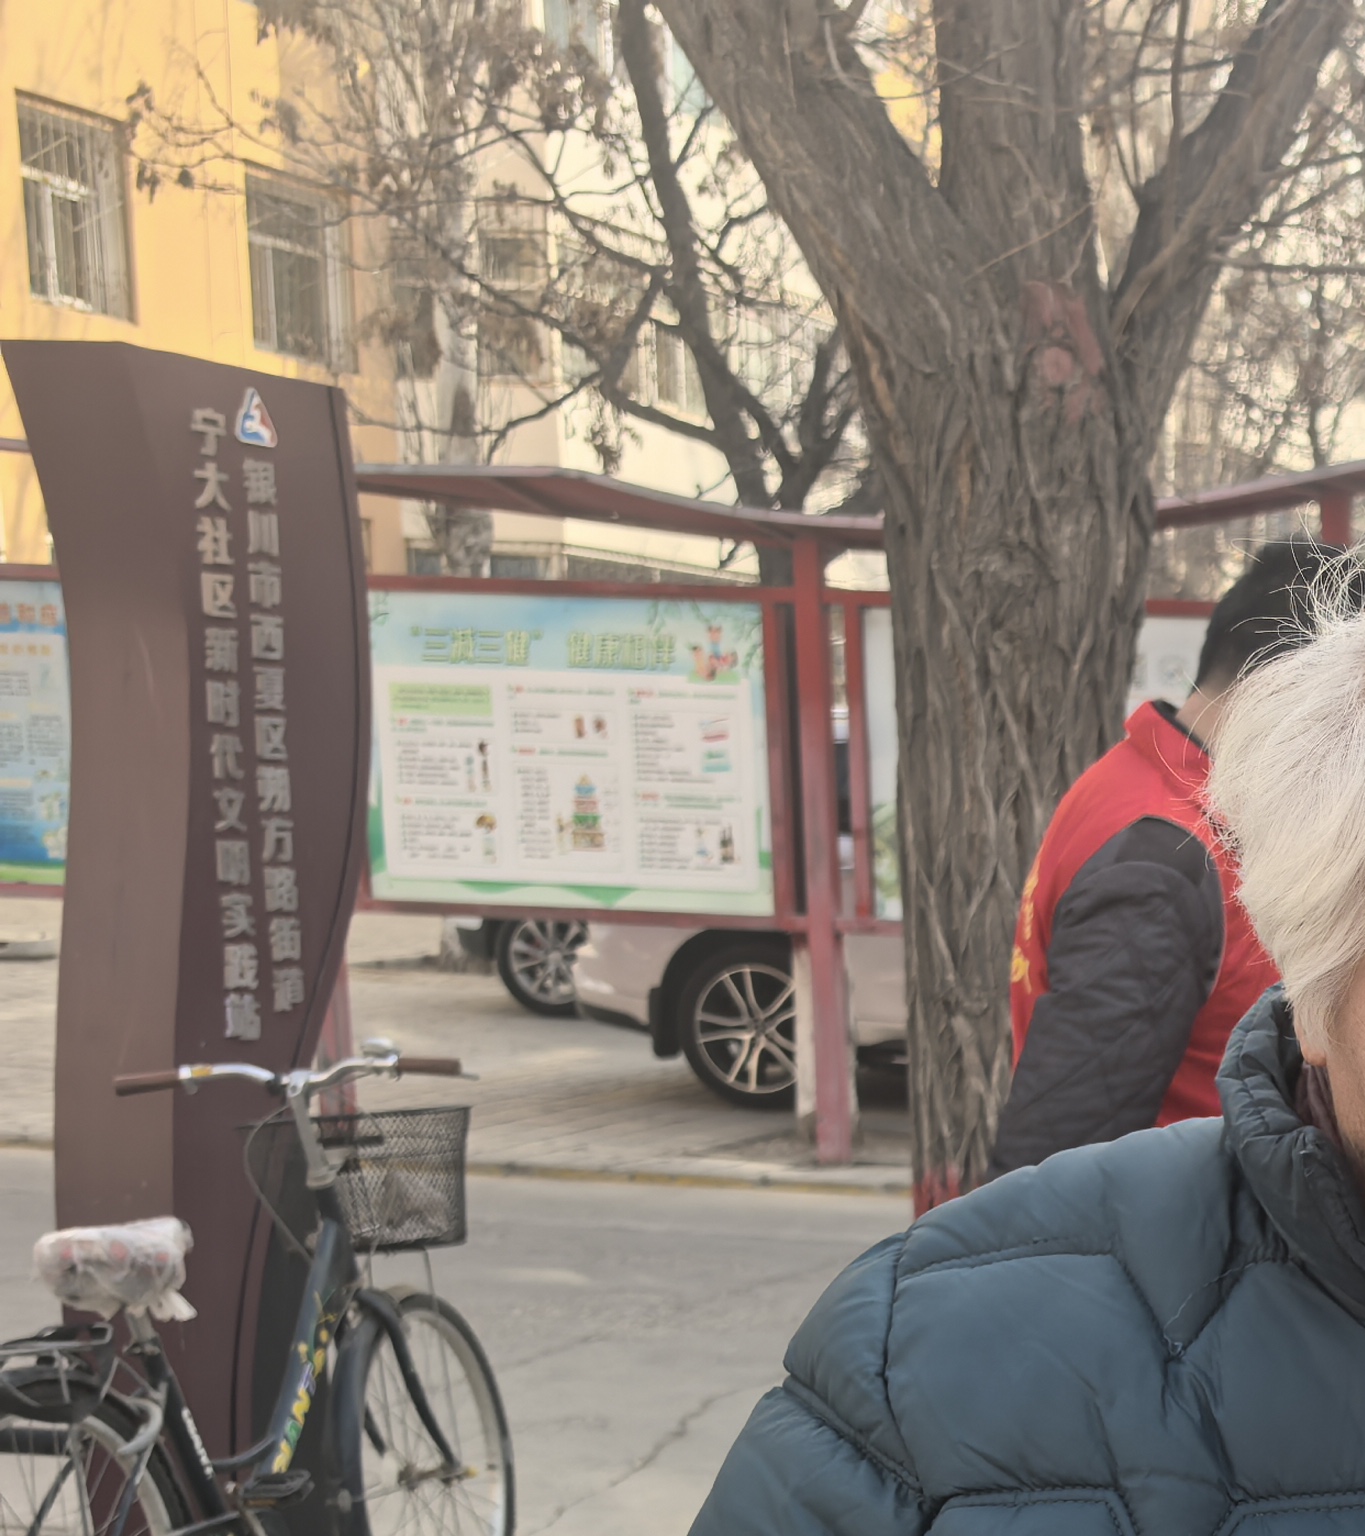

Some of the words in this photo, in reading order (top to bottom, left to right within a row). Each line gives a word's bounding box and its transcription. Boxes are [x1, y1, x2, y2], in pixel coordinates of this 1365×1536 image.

[191, 407, 262, 1040] 宁大社区新时代文明实践站
[243, 457, 305, 1012] 银川市西夏区朔方路街道
